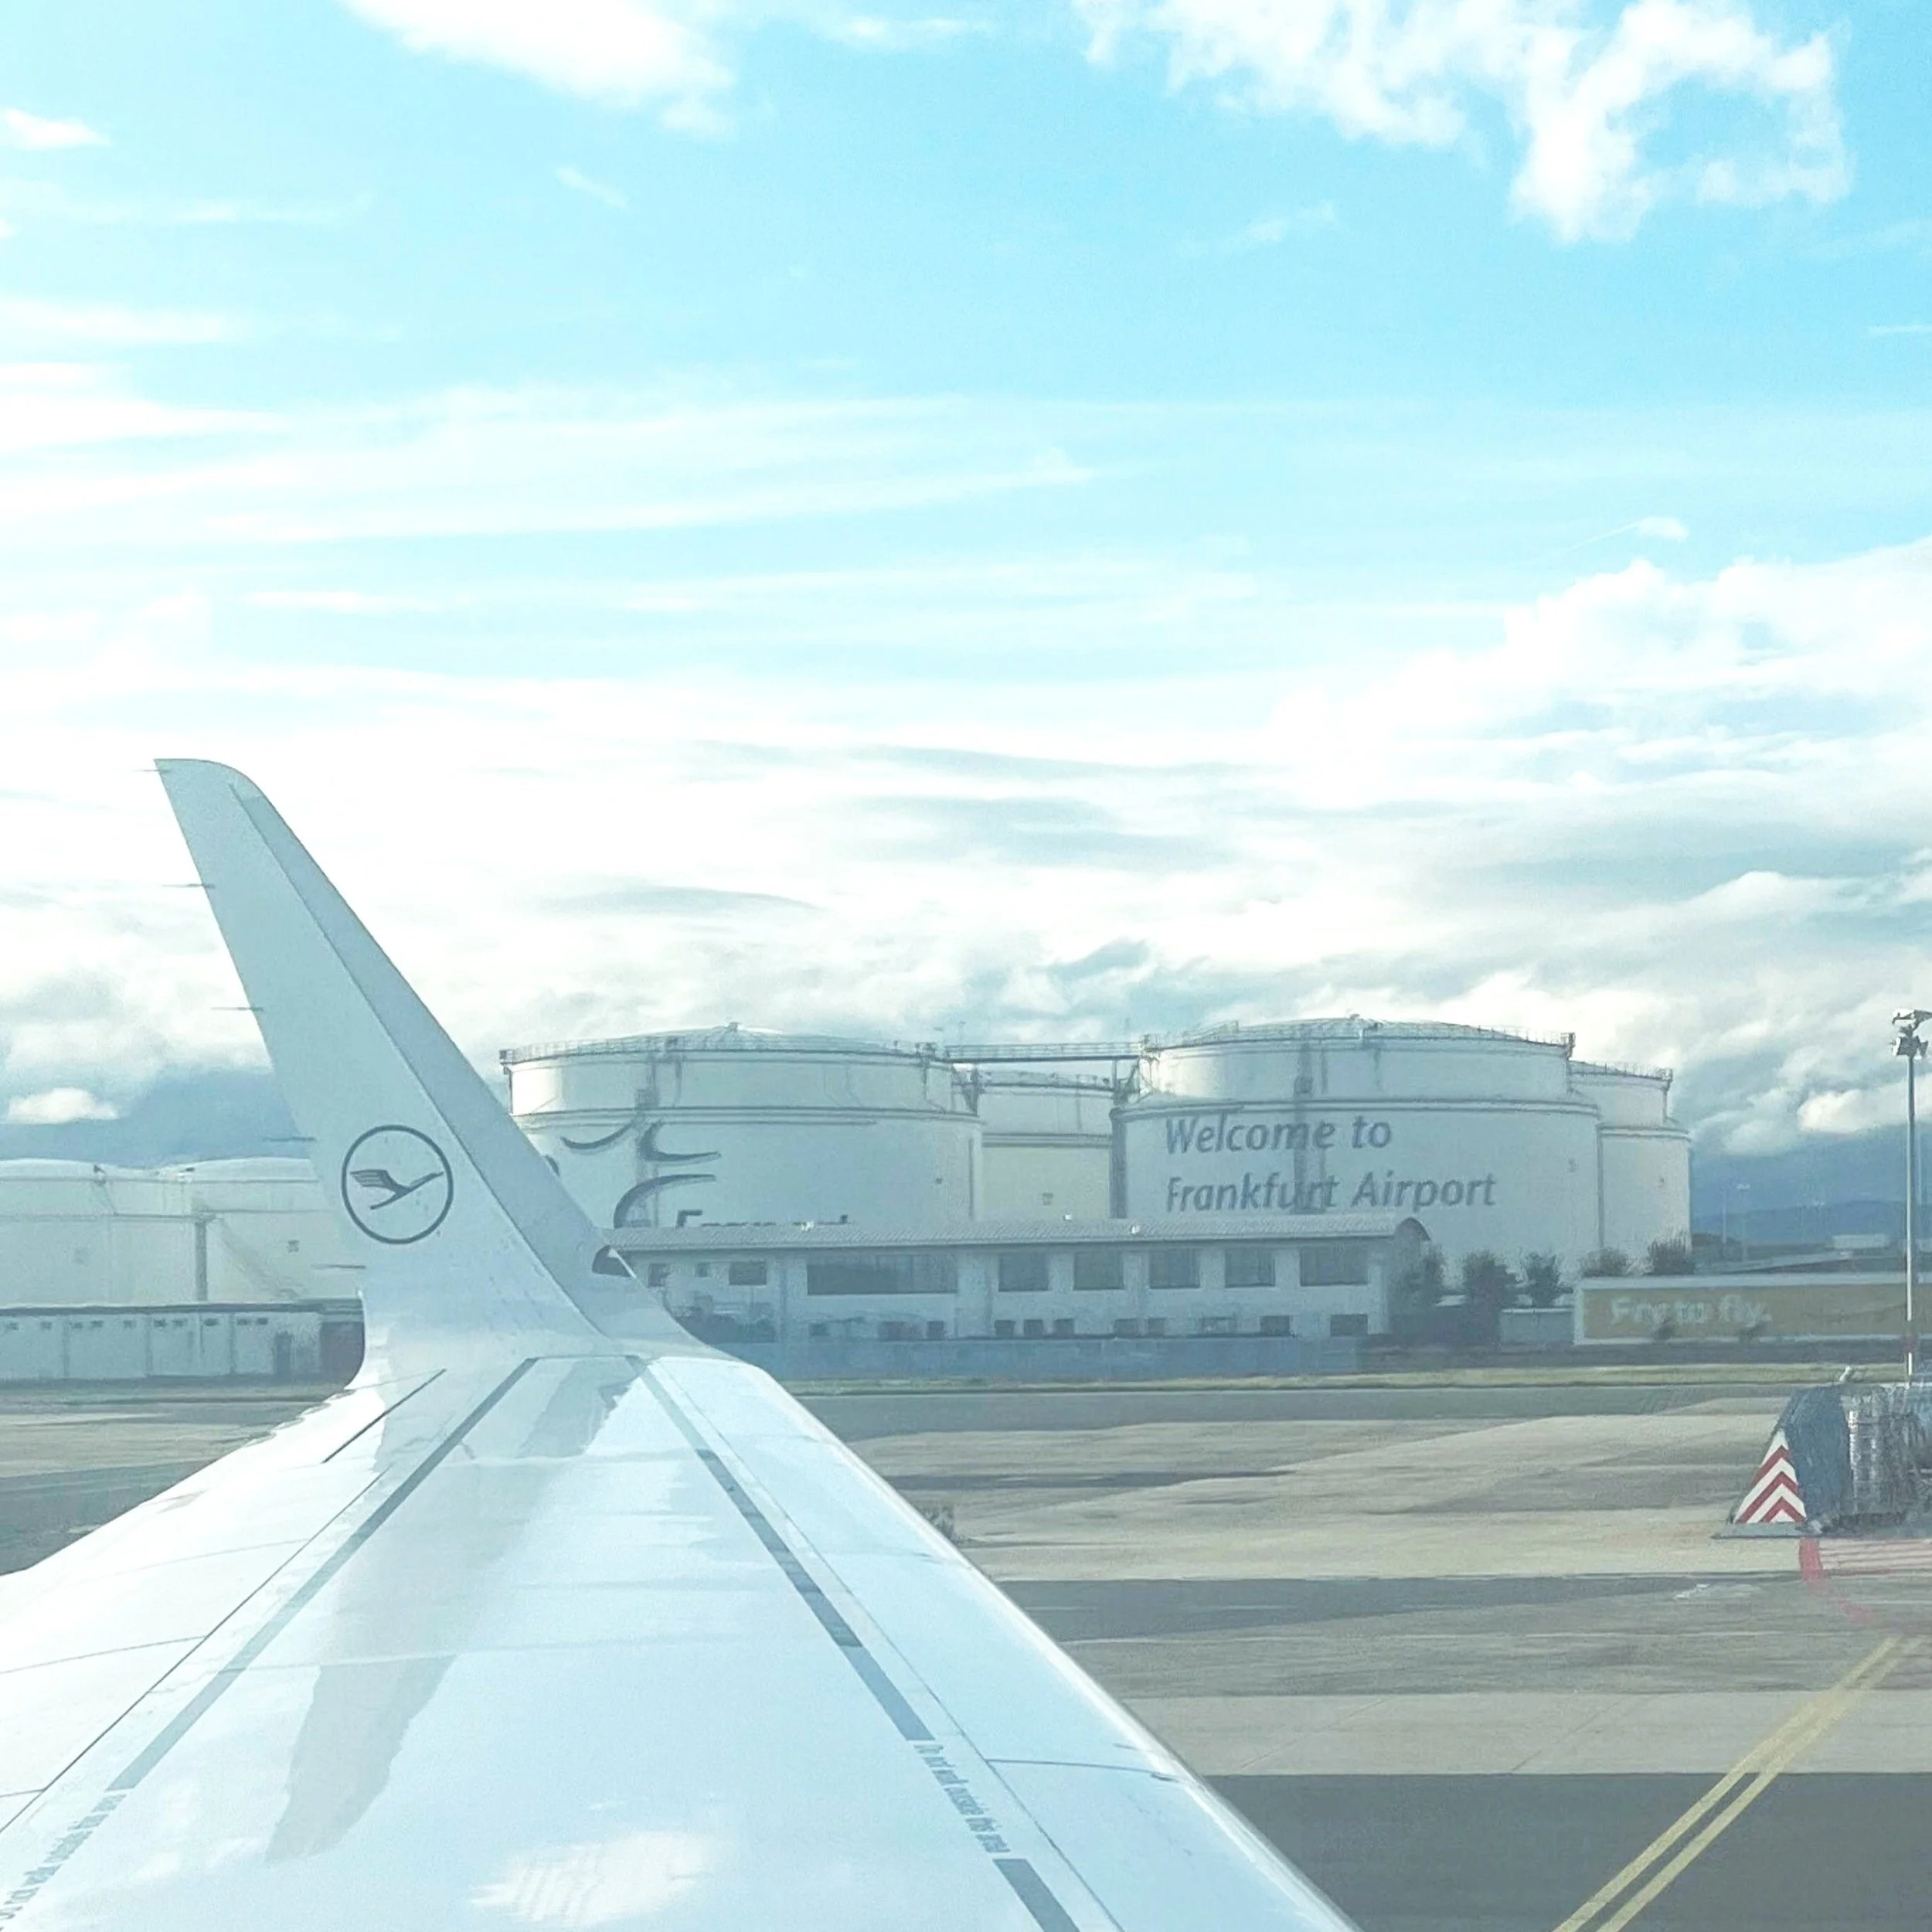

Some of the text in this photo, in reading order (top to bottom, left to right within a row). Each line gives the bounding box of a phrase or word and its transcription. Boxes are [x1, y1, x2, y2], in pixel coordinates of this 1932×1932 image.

[1166, 1113, 1391, 1153] Welcome to
[1166, 1169, 1497, 1213] Frankfurt Airport
